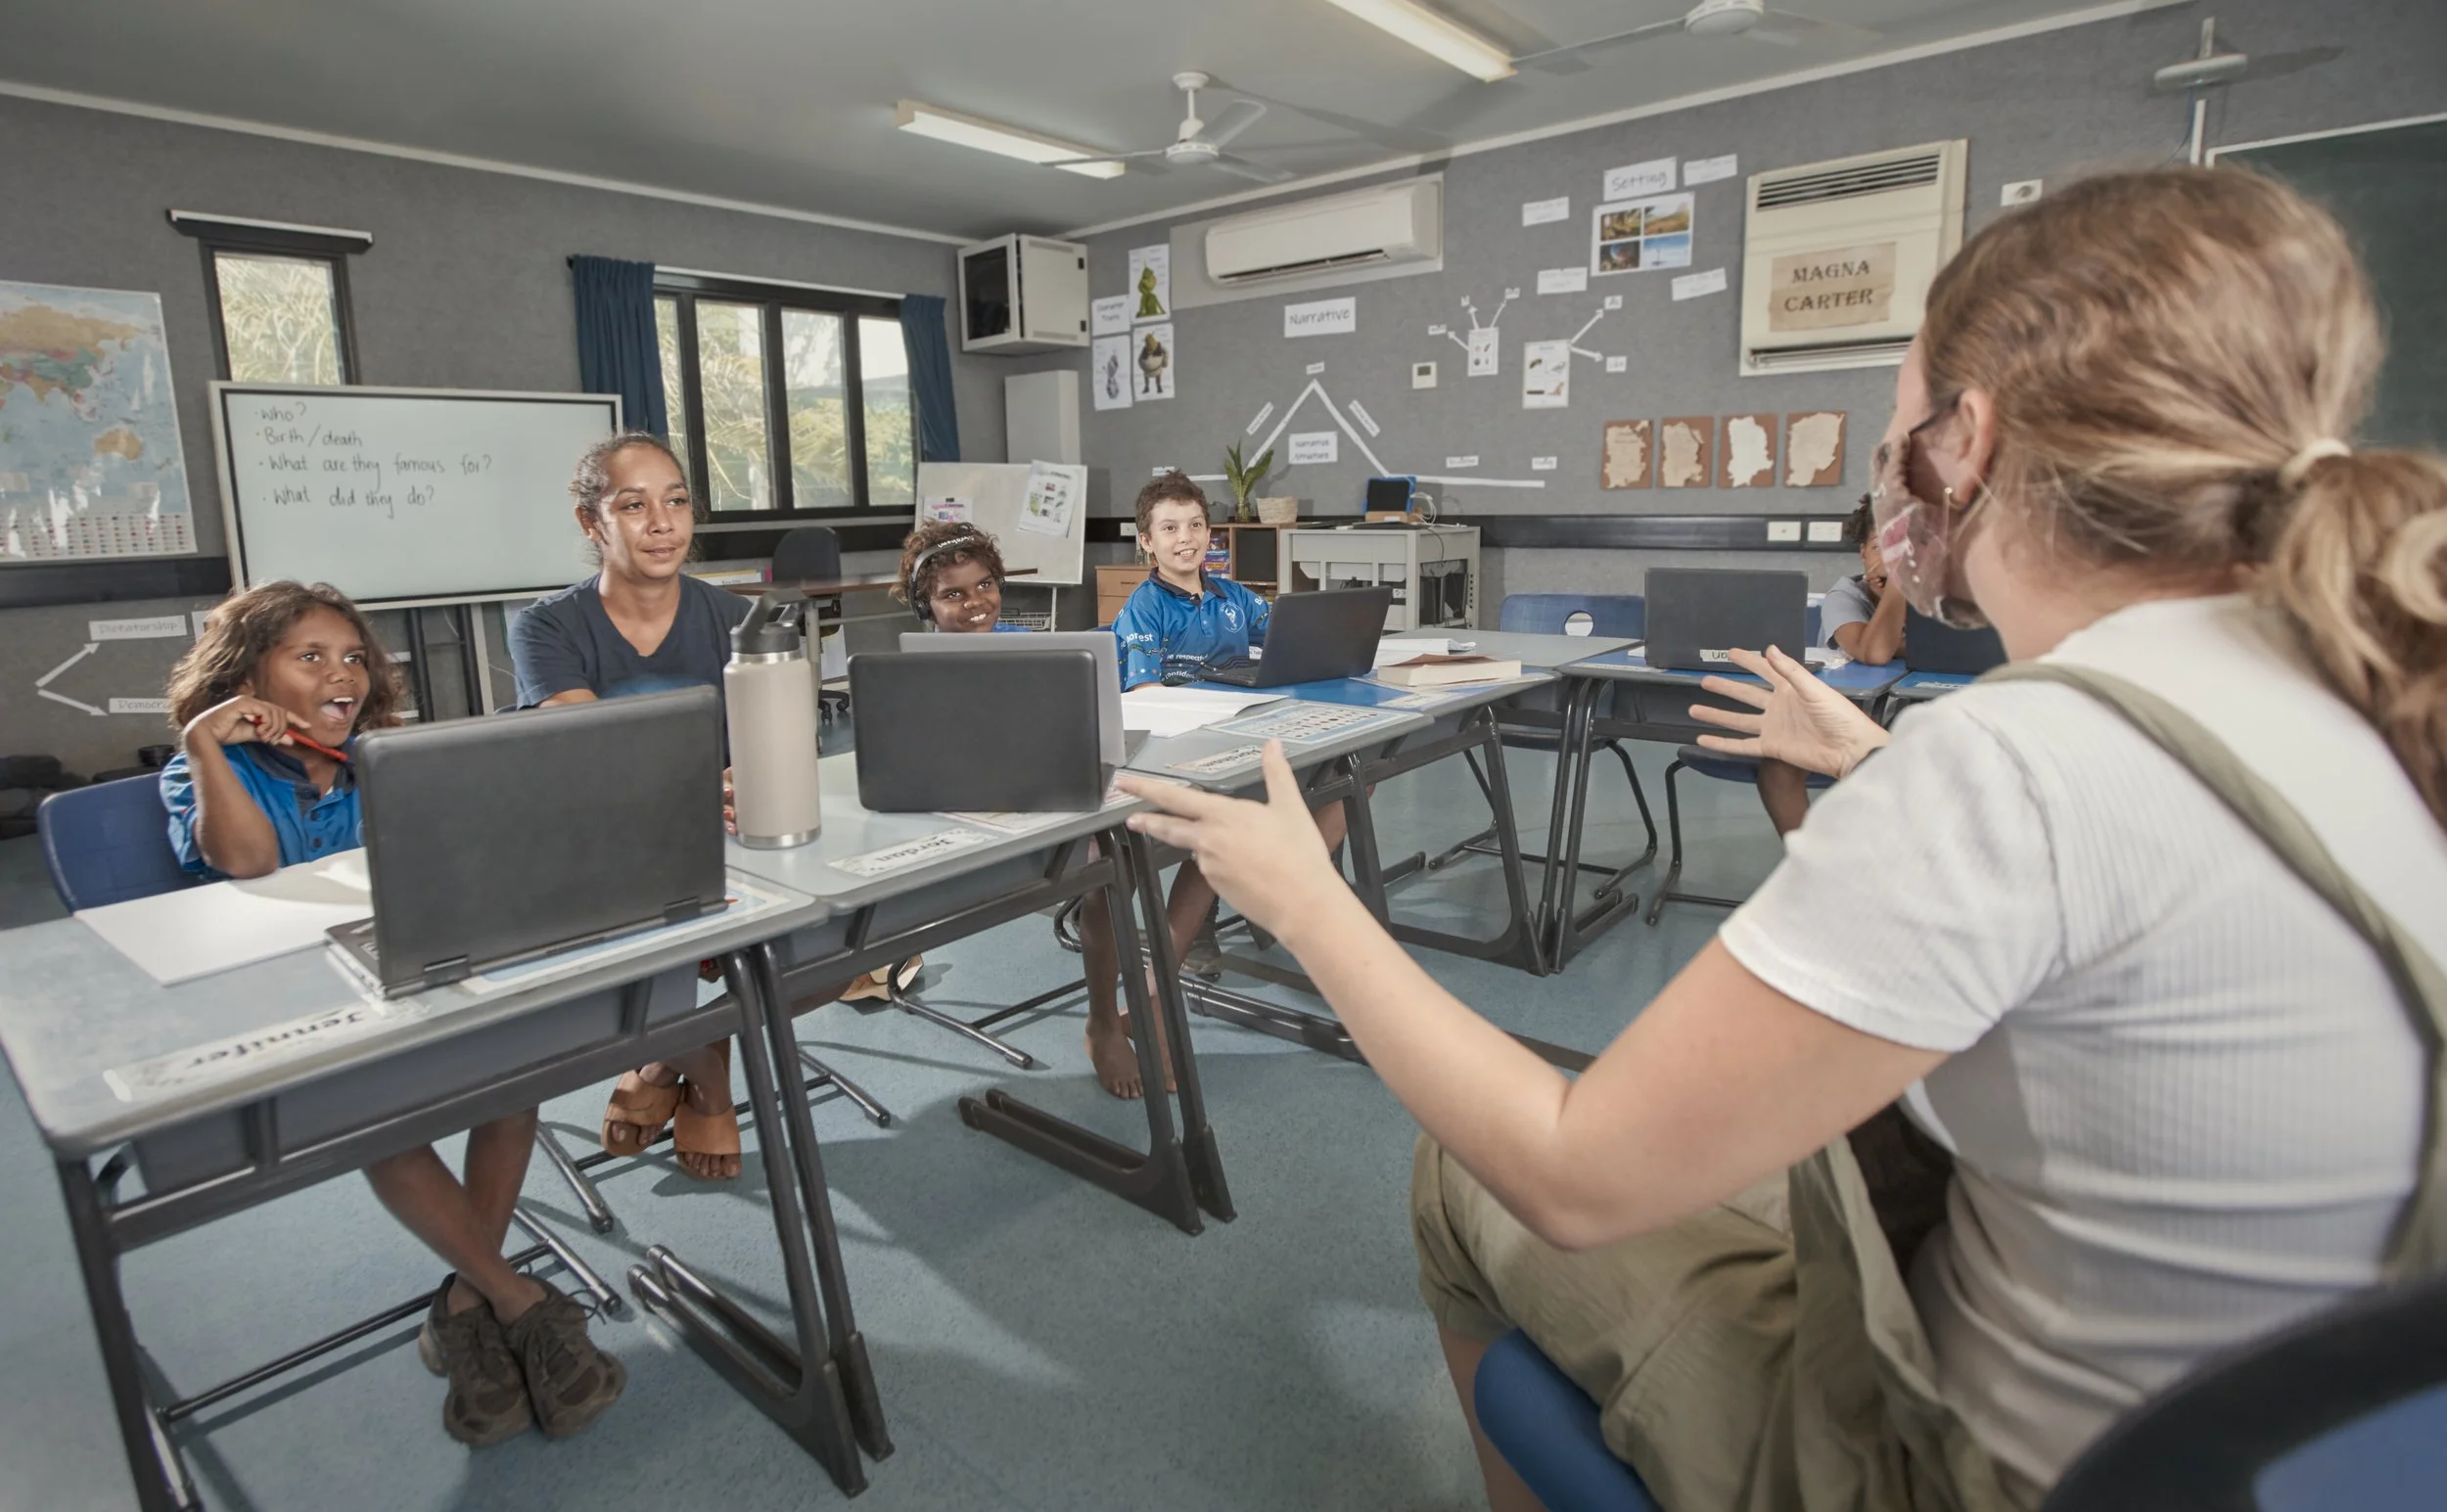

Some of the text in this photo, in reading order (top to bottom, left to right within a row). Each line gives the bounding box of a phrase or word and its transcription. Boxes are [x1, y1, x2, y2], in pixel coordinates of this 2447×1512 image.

[1611, 169, 1667, 193] Setting
[1790, 259, 1871, 284] MAGNA
[1783, 288, 1873, 313] CARTER
[1289, 308, 1351, 325] Narrative
[269, 451, 492, 494] What are they famous for?
[329, 484, 356, 507] did
[365, 488, 394, 521] they
[407, 483, 435, 507] do?
[189, 1012, 364, 1067] Jennifer
